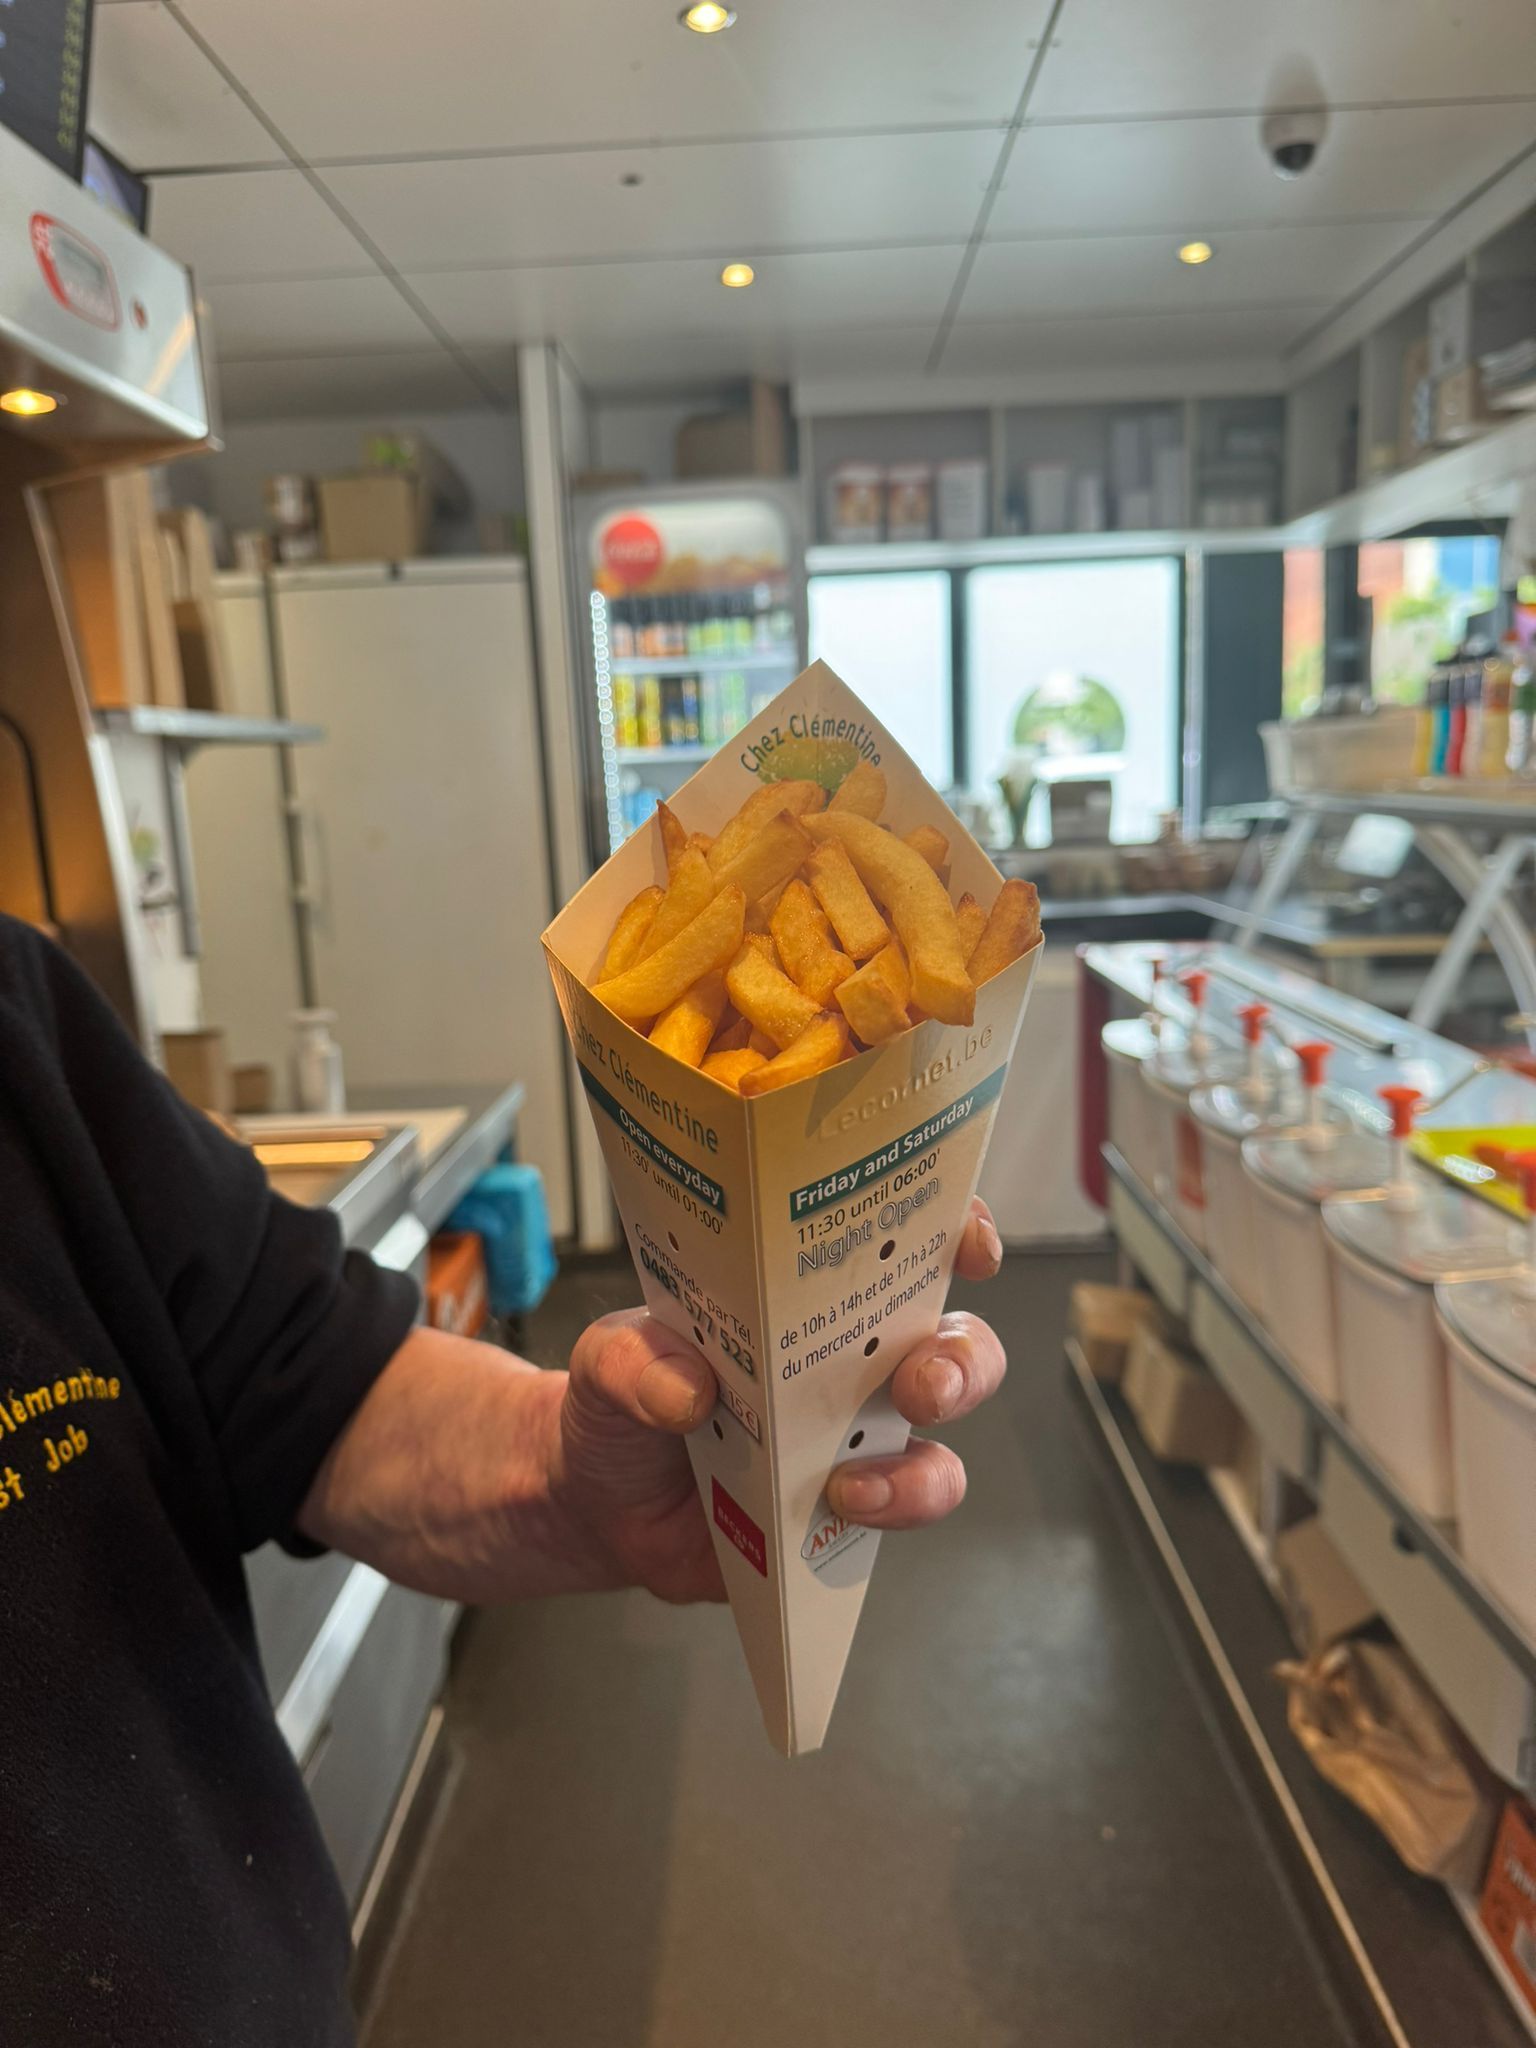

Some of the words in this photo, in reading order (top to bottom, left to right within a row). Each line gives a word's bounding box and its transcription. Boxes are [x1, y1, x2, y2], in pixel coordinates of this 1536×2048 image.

[740, 727, 784, 773] Chez
[789, 714, 881, 768] Clémentine
[609, 1048, 719, 1153] Clémentine
[619, 1108, 651, 1152] Open
[653, 1143, 720, 1206] everyday
[653, 1170, 680, 1204] until
[796, 1167, 860, 1212] Friday
[864, 1142, 899, 1177] and
[903, 1096, 974, 1155] Saturday
[797, 1208, 846, 1244] 11:30
[850, 1181, 889, 1218] until
[893, 1148, 941, 1192] 06:00'
[635, 1223, 703, 1301] Commande
[706, 1296, 728, 1325] par
[797, 1218, 872, 1278] Night
[877, 1177, 940, 1227] Open
[640, 1246, 680, 1299] 0483
[683, 1290, 714, 1335] 577
[719, 1327, 755, 1376] 523
[780, 1329, 798, 1350] de
[801, 1313, 826, 1339] 10h
[829, 1306, 837, 1324] à
[840, 1291, 863, 1317] 14h
[865, 1282, 877, 1301] et
[879, 1271, 894, 1292] de
[920, 1244, 927, 1261] à
[928, 1229, 947, 1257] 22h
[782, 1358, 801, 1381] du
[806, 1317, 864, 1370] mercredi
[867, 1311, 882, 1330] au
[885, 1264, 940, 1317] dimanche
[43, 1424, 88, 1472] Job
